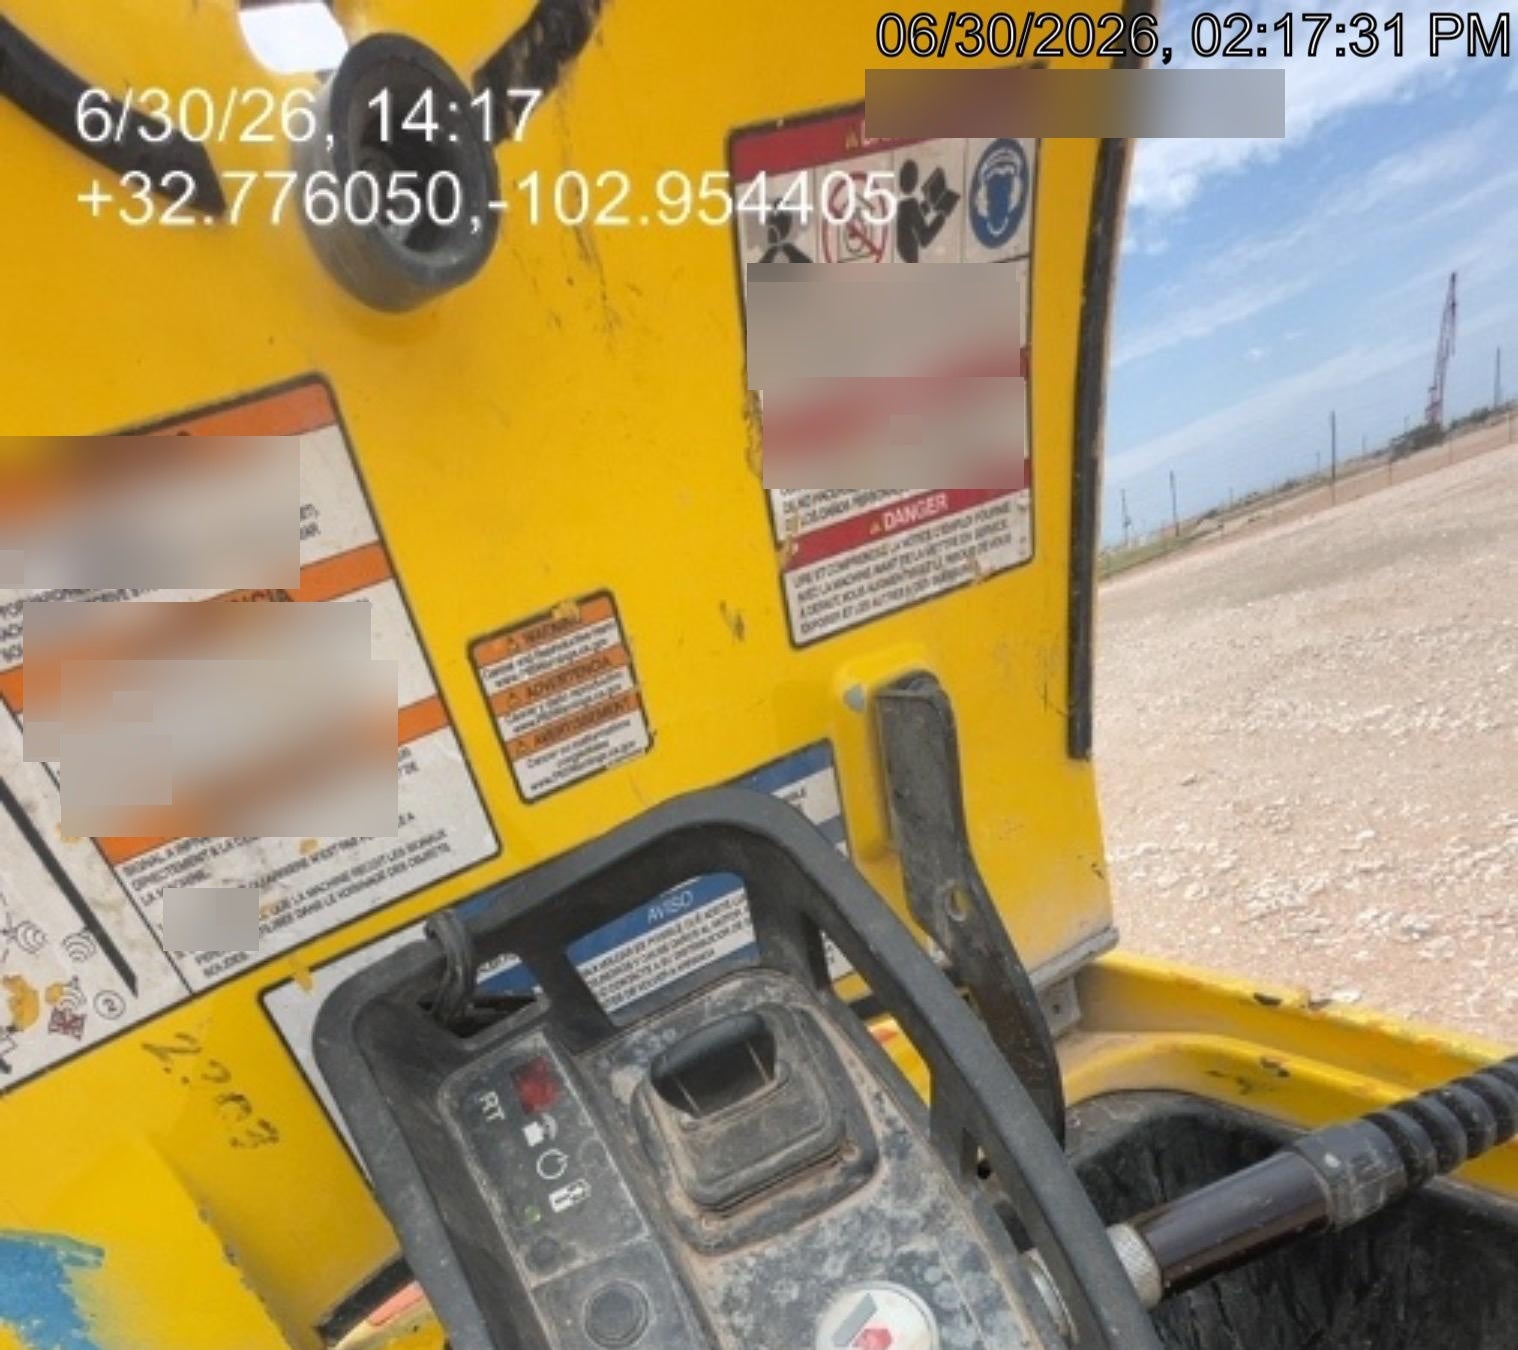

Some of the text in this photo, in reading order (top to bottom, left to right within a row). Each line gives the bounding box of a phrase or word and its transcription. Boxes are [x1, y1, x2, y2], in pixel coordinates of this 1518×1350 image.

[883, 493, 949, 530] DANGER
[647, 890, 694, 924] AVISO
[479, 1090, 506, 1123] RT
